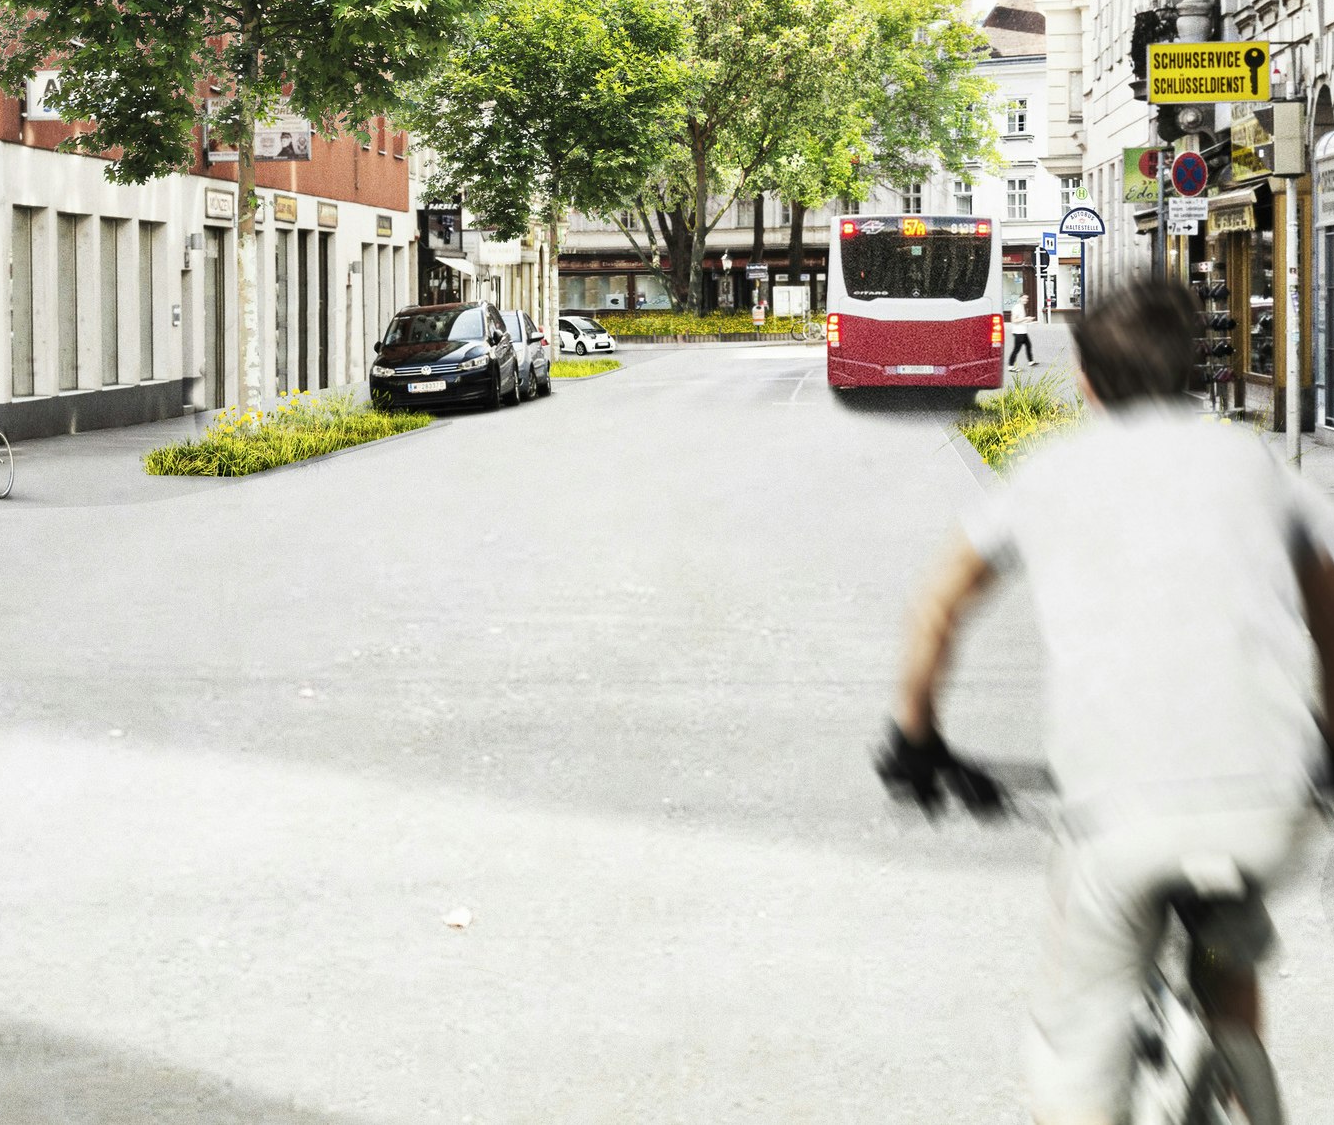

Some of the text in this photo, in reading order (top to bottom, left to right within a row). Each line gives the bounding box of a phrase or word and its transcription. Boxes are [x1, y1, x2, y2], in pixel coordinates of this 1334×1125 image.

[1153, 50, 1241, 70] SCHUHSERVICE
[1153, 74, 1246, 95] SCHLÜSSELDIENST
[1070, 211, 1095, 221] AUTOBUS
[903, 219, 926, 235] 57A
